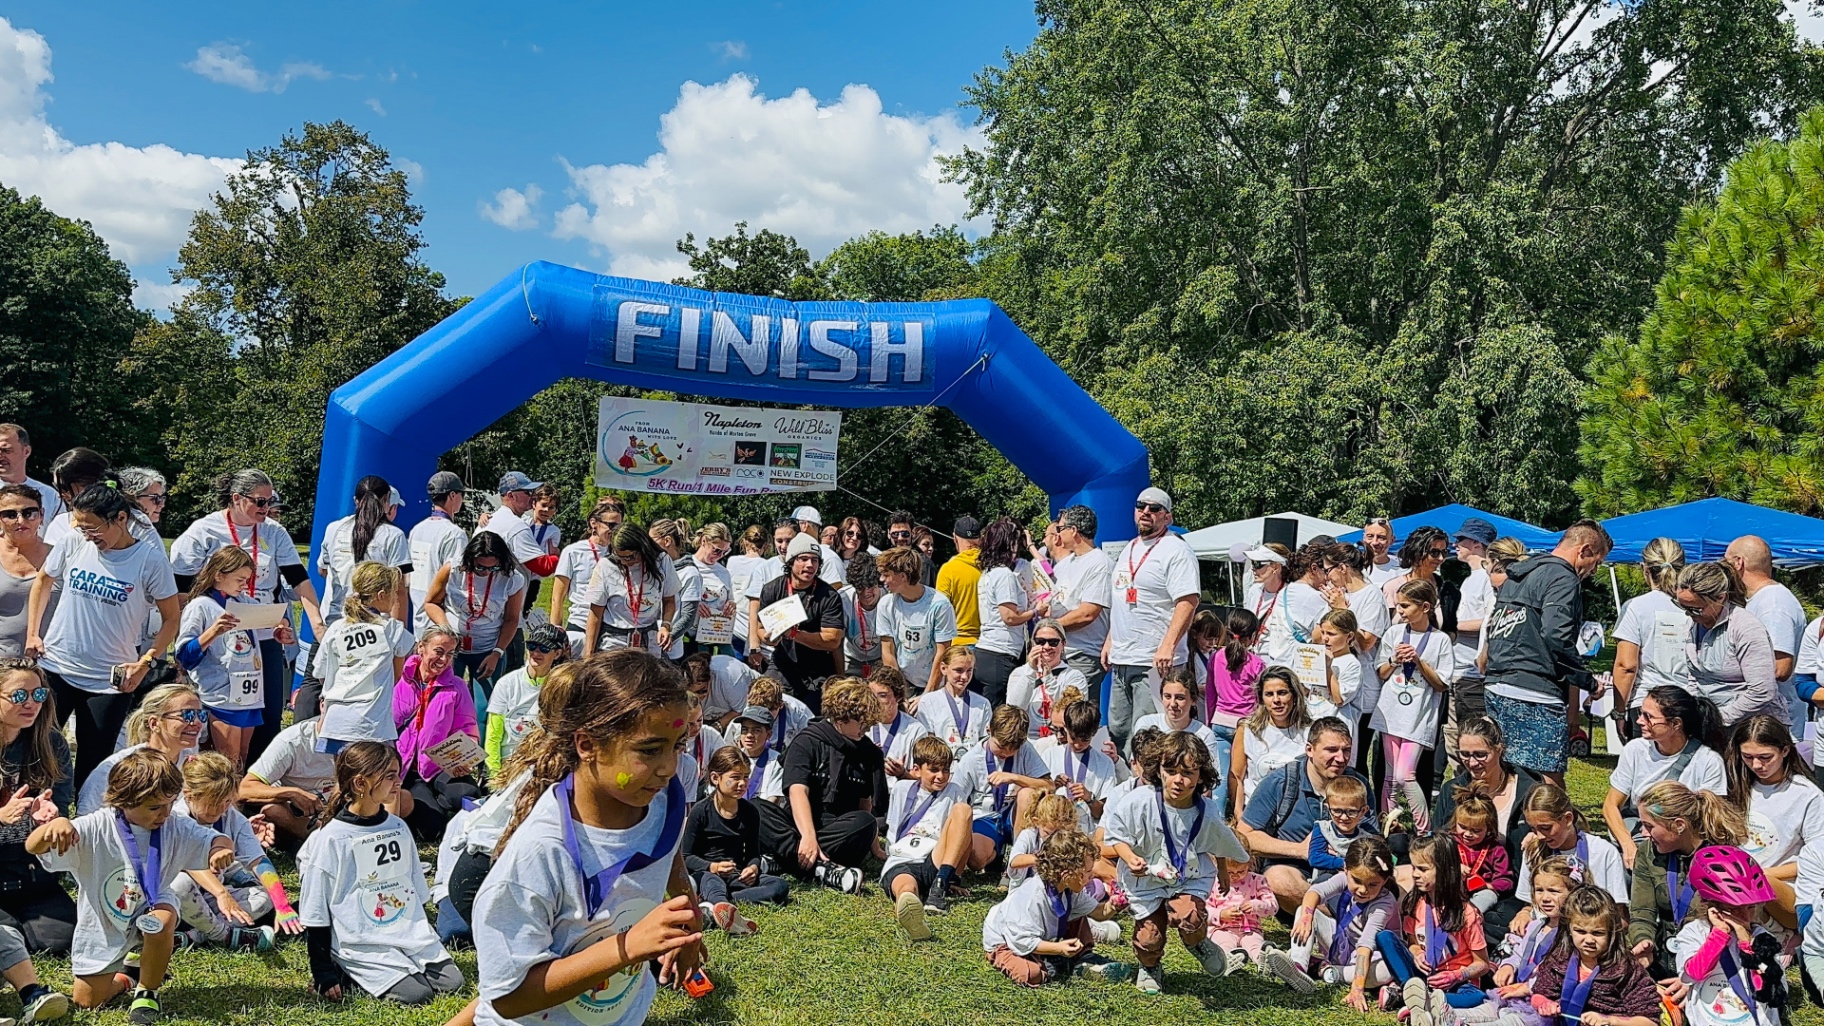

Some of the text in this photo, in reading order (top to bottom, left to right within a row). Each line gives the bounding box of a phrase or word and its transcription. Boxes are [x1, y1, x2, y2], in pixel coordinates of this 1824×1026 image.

[615, 301, 923, 383] FINISH
[704, 411, 762, 430] Napleton
[774, 416, 833, 435] Wild Bliss
[637, 426, 670, 435] BANANA
[770, 469, 835, 481] NEW EXPLODE
[648, 478, 666, 489] 5K
[668, 480, 702, 492] Run/1
[705, 484, 731, 494] Mile
[70, 567, 106, 587] CARA
[69, 578, 128, 602] TRAINING
[344, 629, 377, 651] 209
[905, 630, 920, 642] 63
[242, 679, 259, 694] 99
[361, 837, 375, 845] Ana
[910, 837, 921, 848] 6
[374, 840, 402, 866] 29
